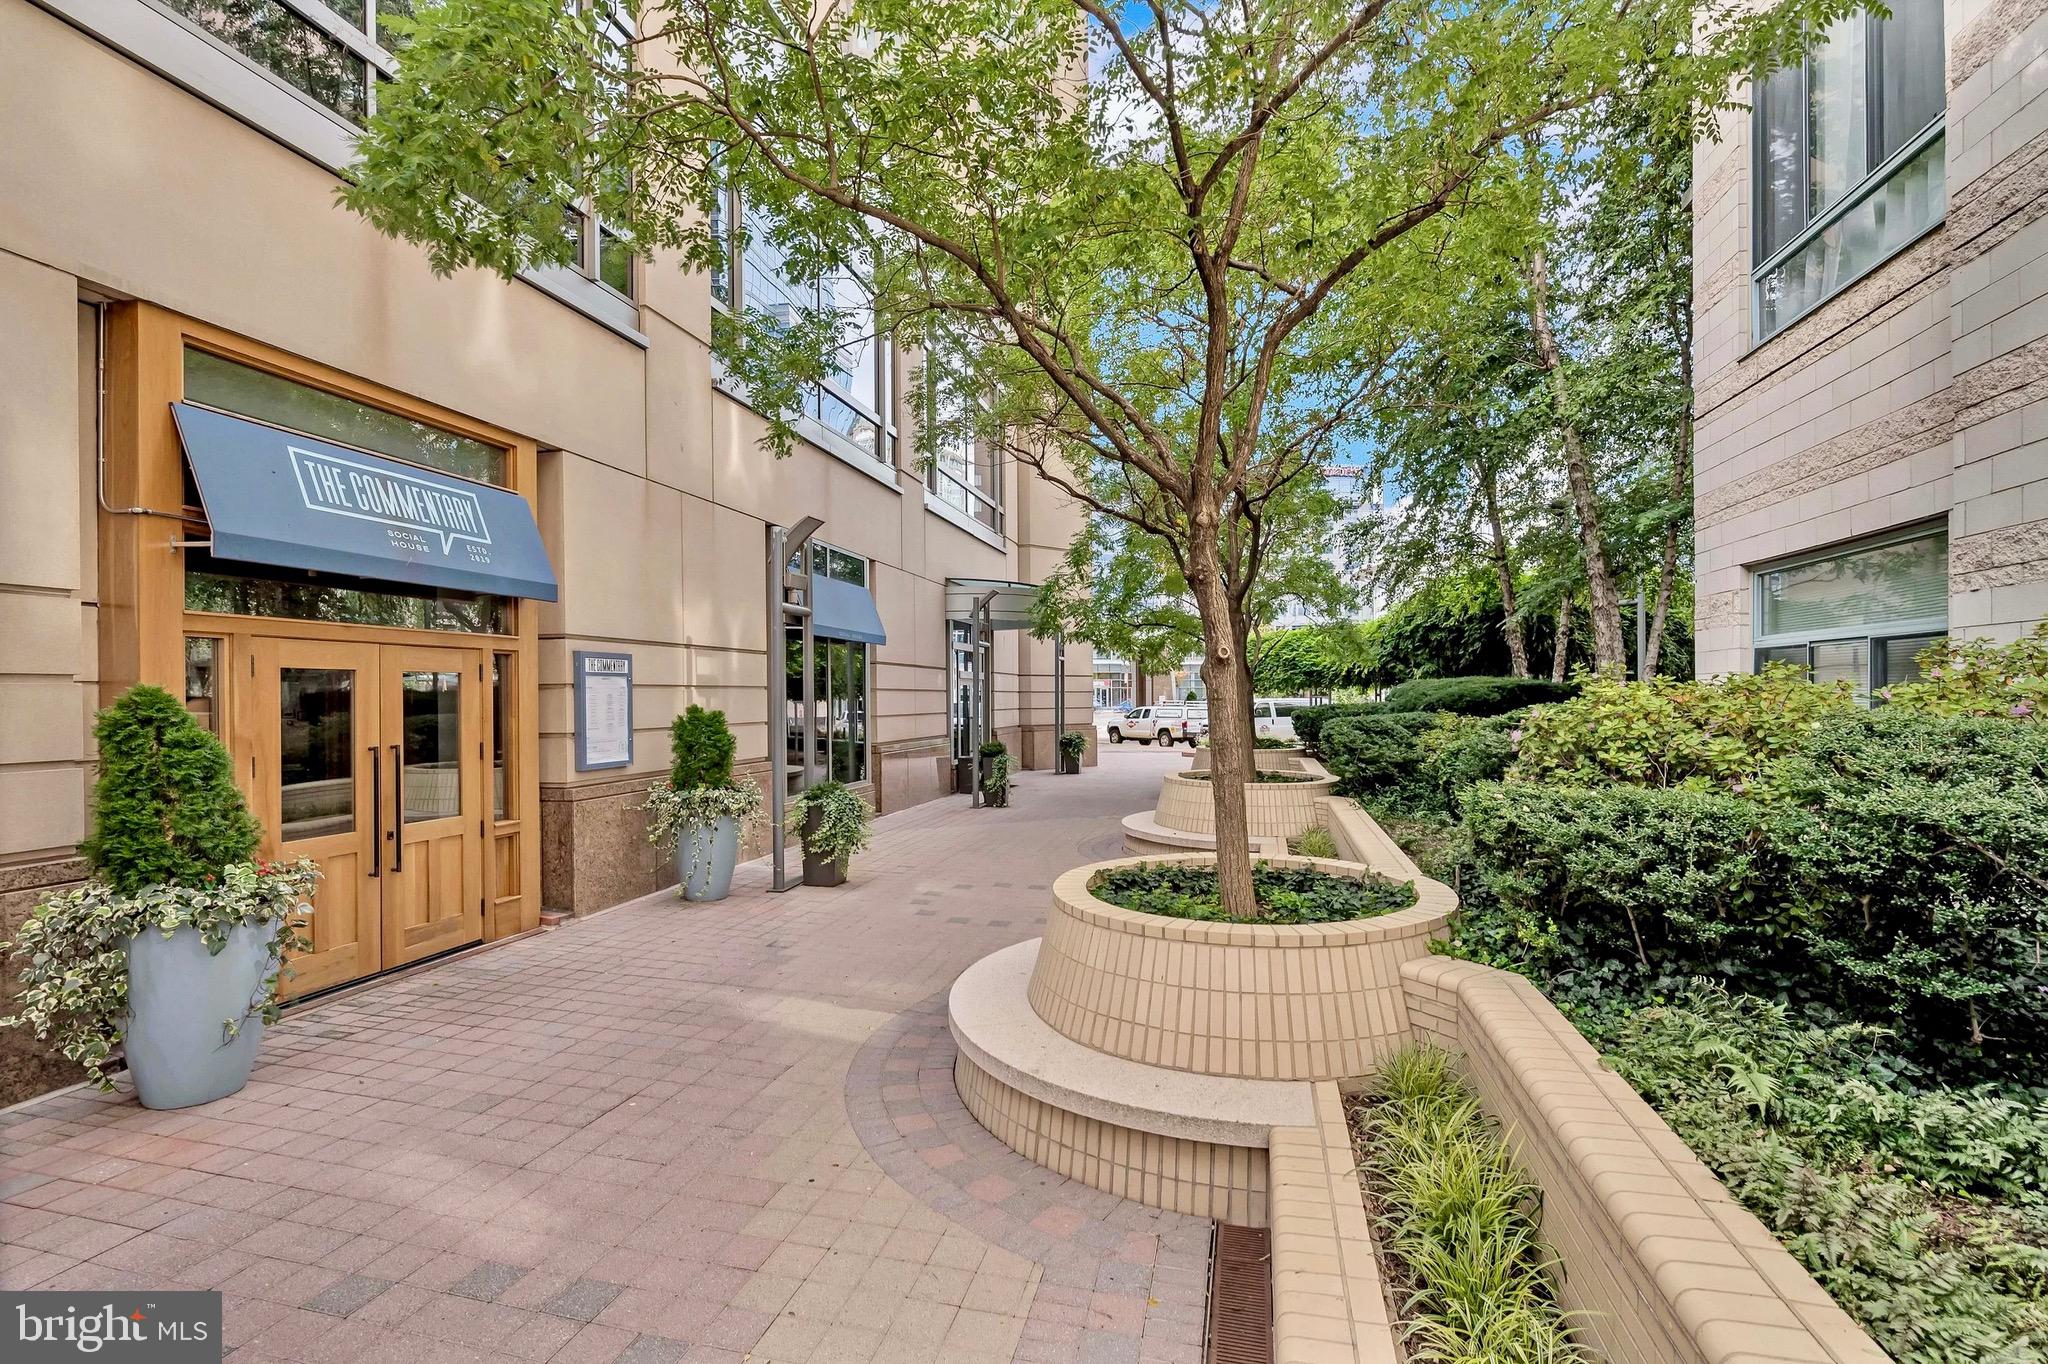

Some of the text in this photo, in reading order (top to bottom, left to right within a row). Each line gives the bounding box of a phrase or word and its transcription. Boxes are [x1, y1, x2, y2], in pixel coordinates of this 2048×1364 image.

[304, 460, 478, 533] THE COMMENTARY
[387, 530, 426, 542] SOCIAL
[391, 541, 430, 552] HOUSE
[469, 554, 490, 564] 2019
[588, 658, 626, 672] THE COMMENTARY
